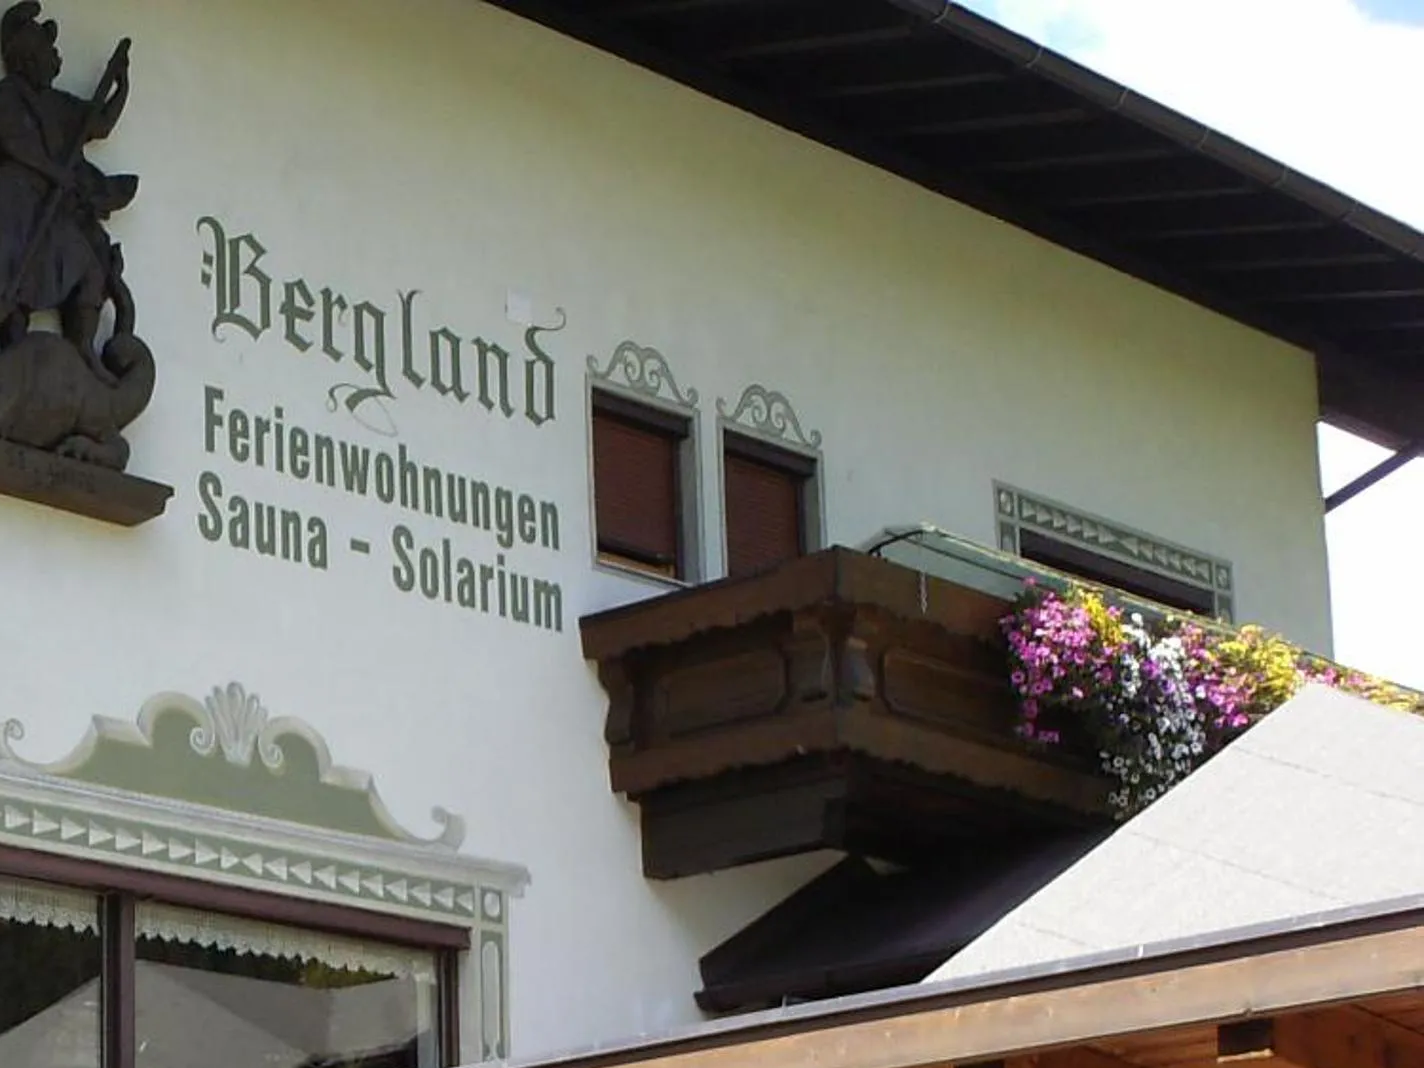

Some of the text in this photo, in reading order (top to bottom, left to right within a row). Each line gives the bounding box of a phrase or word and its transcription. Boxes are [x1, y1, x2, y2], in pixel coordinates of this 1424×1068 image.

[196, 216, 566, 436] Bergland
[204, 385, 561, 551] Ferienwohnungen
[198, 470, 329, 571] Sauna
[391, 524, 564, 633] Solarium
